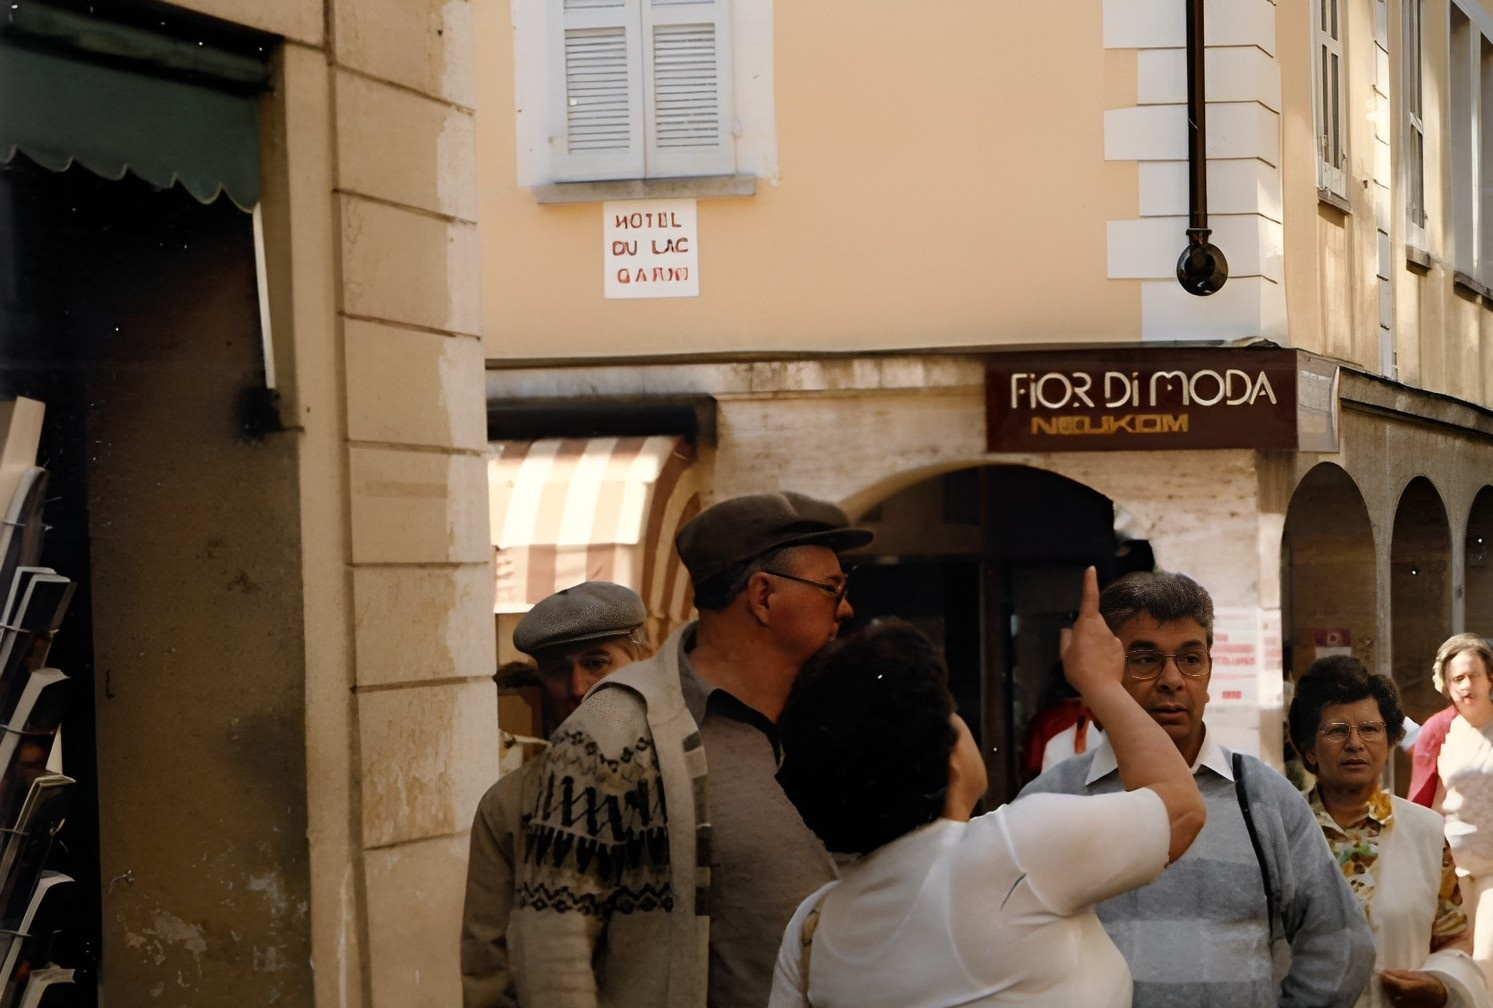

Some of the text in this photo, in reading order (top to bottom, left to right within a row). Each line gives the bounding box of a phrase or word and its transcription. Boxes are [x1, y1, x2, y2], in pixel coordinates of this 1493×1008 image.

[615, 212, 682, 229] HOTEL
[612, 237, 689, 256] DU LAC
[1150, 369, 1277, 407] MODA
